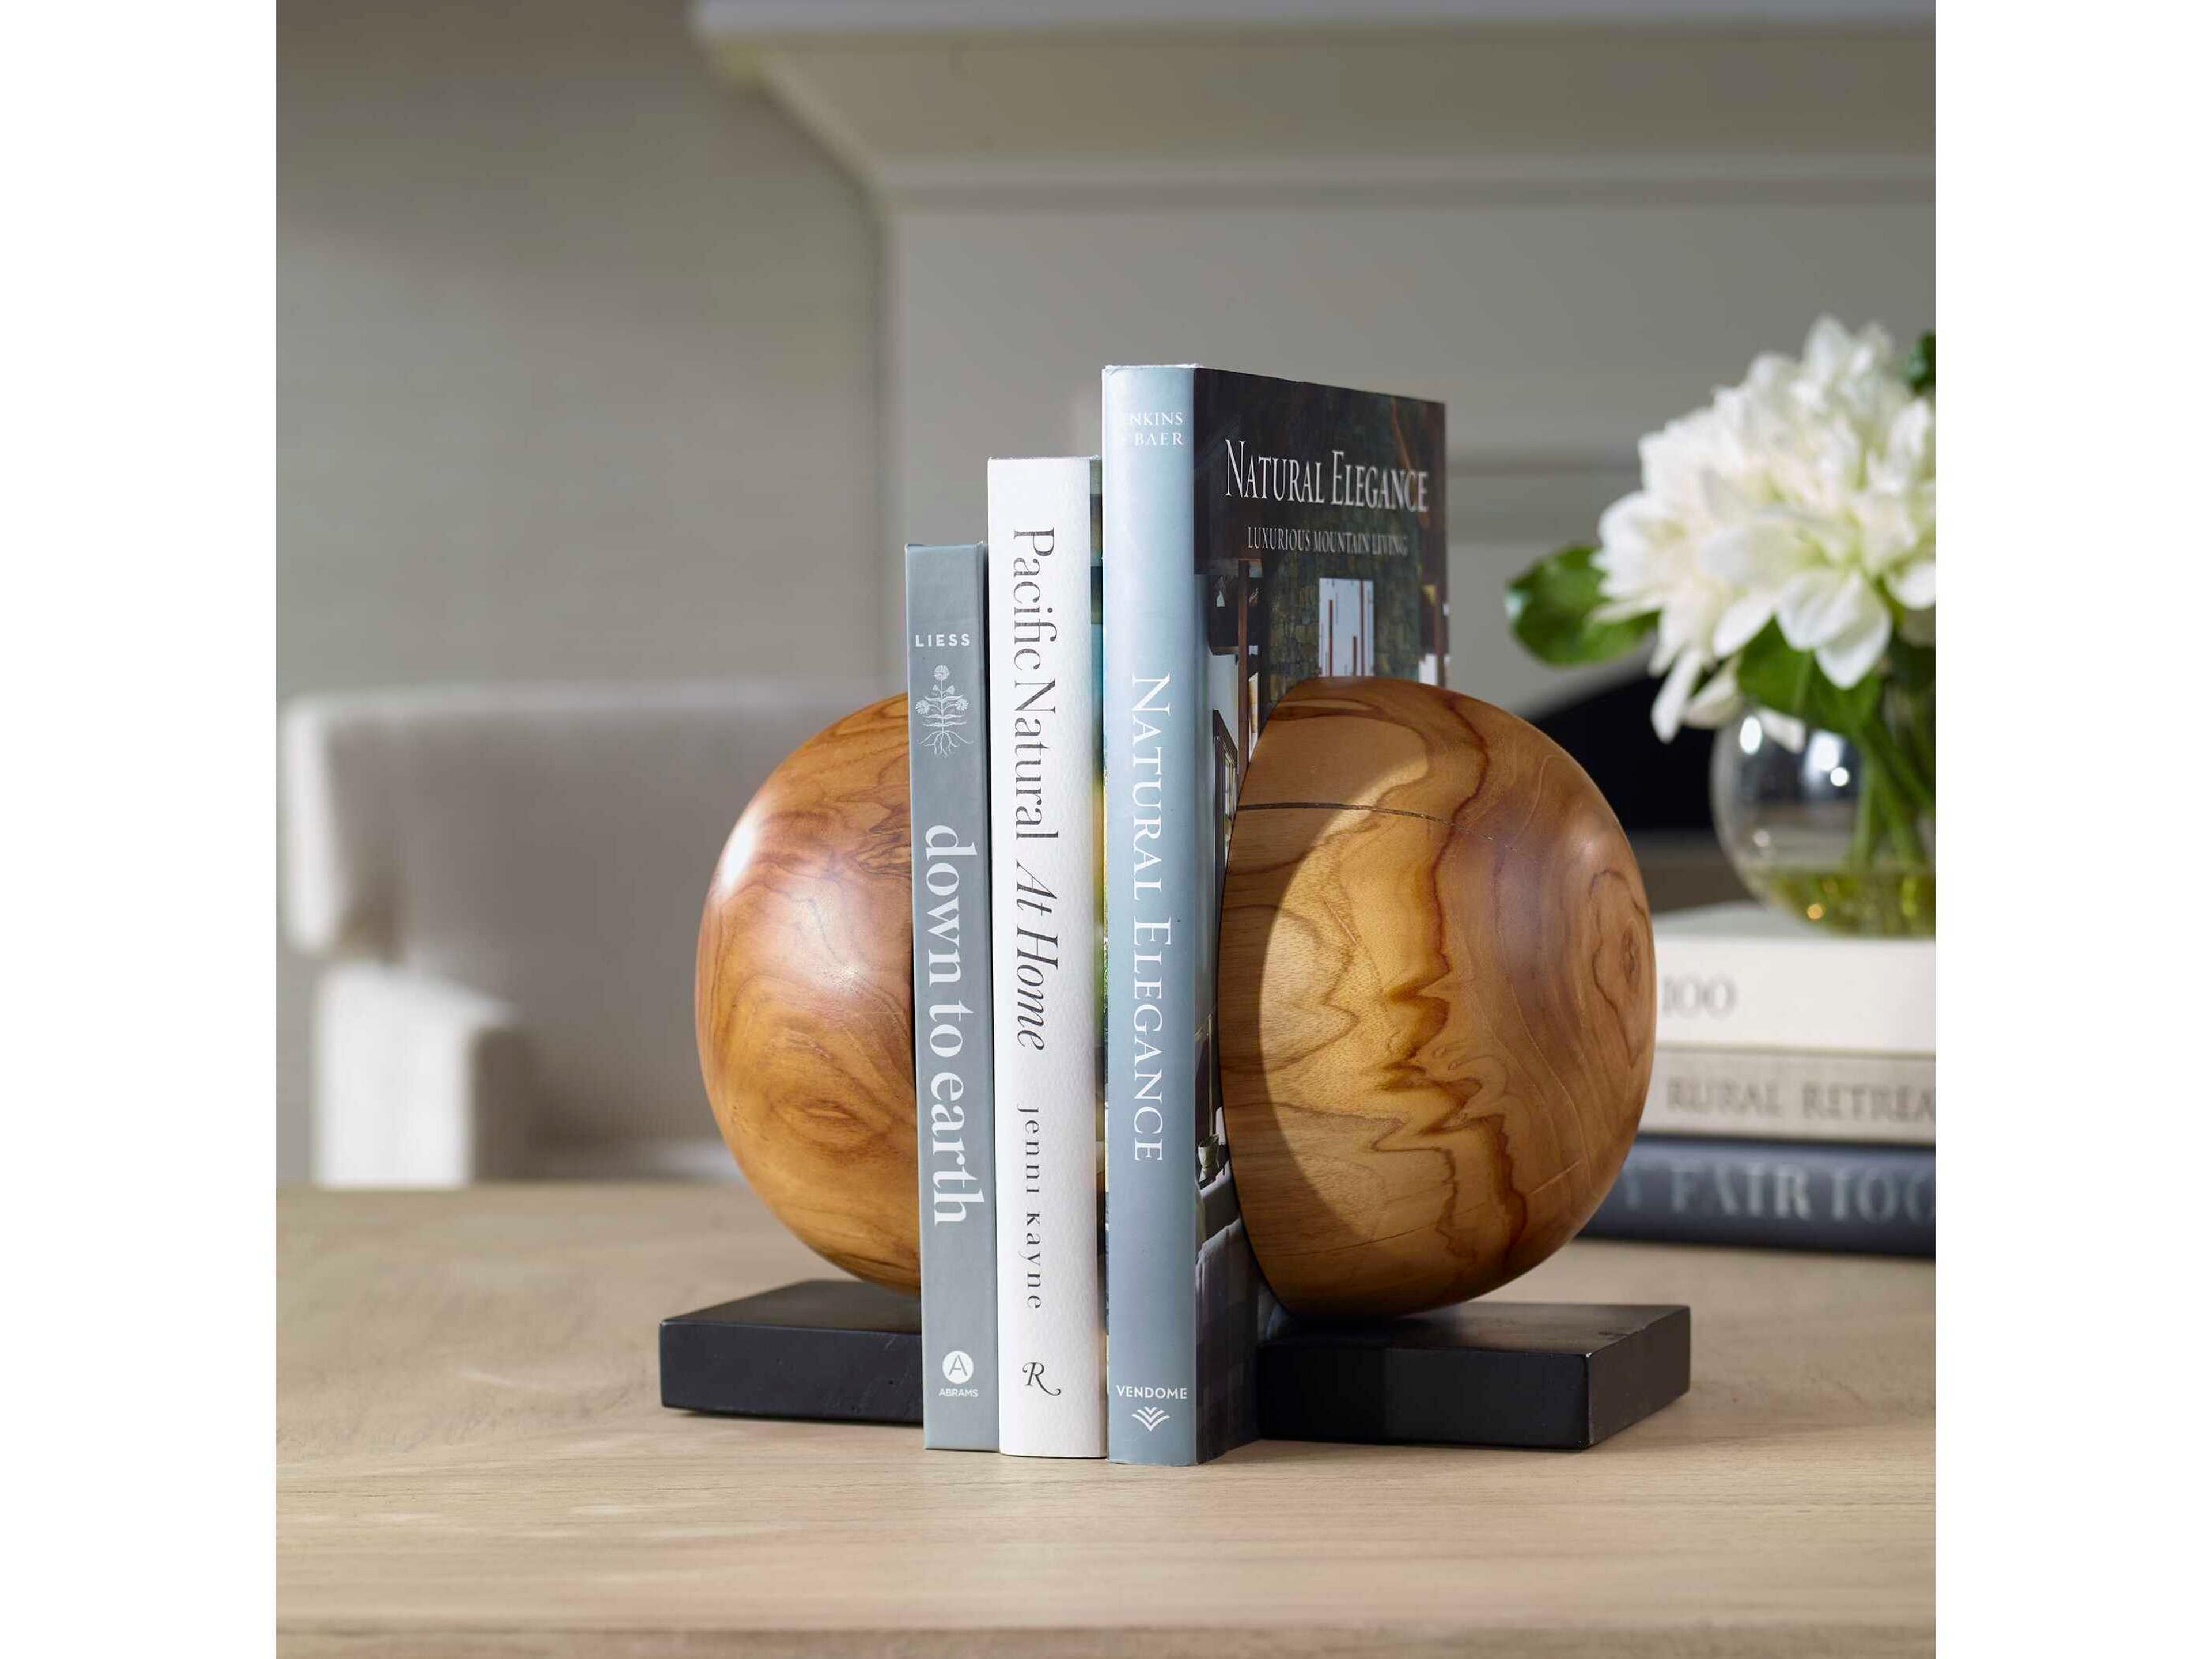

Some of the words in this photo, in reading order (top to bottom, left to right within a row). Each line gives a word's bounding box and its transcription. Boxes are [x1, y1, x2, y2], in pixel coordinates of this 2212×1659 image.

[1134, 432, 1183, 445] BAER
[1248, 526, 1310, 552] LUXURIOUS
[1313, 530, 1371, 555] MOUNTAIN
[1372, 533, 1409, 558] LIVING
[1013, 527, 1058, 671] Pacific
[915, 633, 971, 647] LIESS
[1014, 680, 1059, 839] Natural
[925, 824, 978, 987] down
[1016, 859, 1058, 916] At
[1016, 926, 1059, 1051] Home
[929, 999, 975, 1058] to
[1666, 1074, 1782, 1118] RURAL
[930, 1071, 985, 1226] earth
[1668, 1162, 1812, 1221] FAIR
[939, 1388, 979, 1397] ABRAMS
[1022, 1362, 1062, 1396] R
[1116, 1385, 1187, 1400] VENDOME
